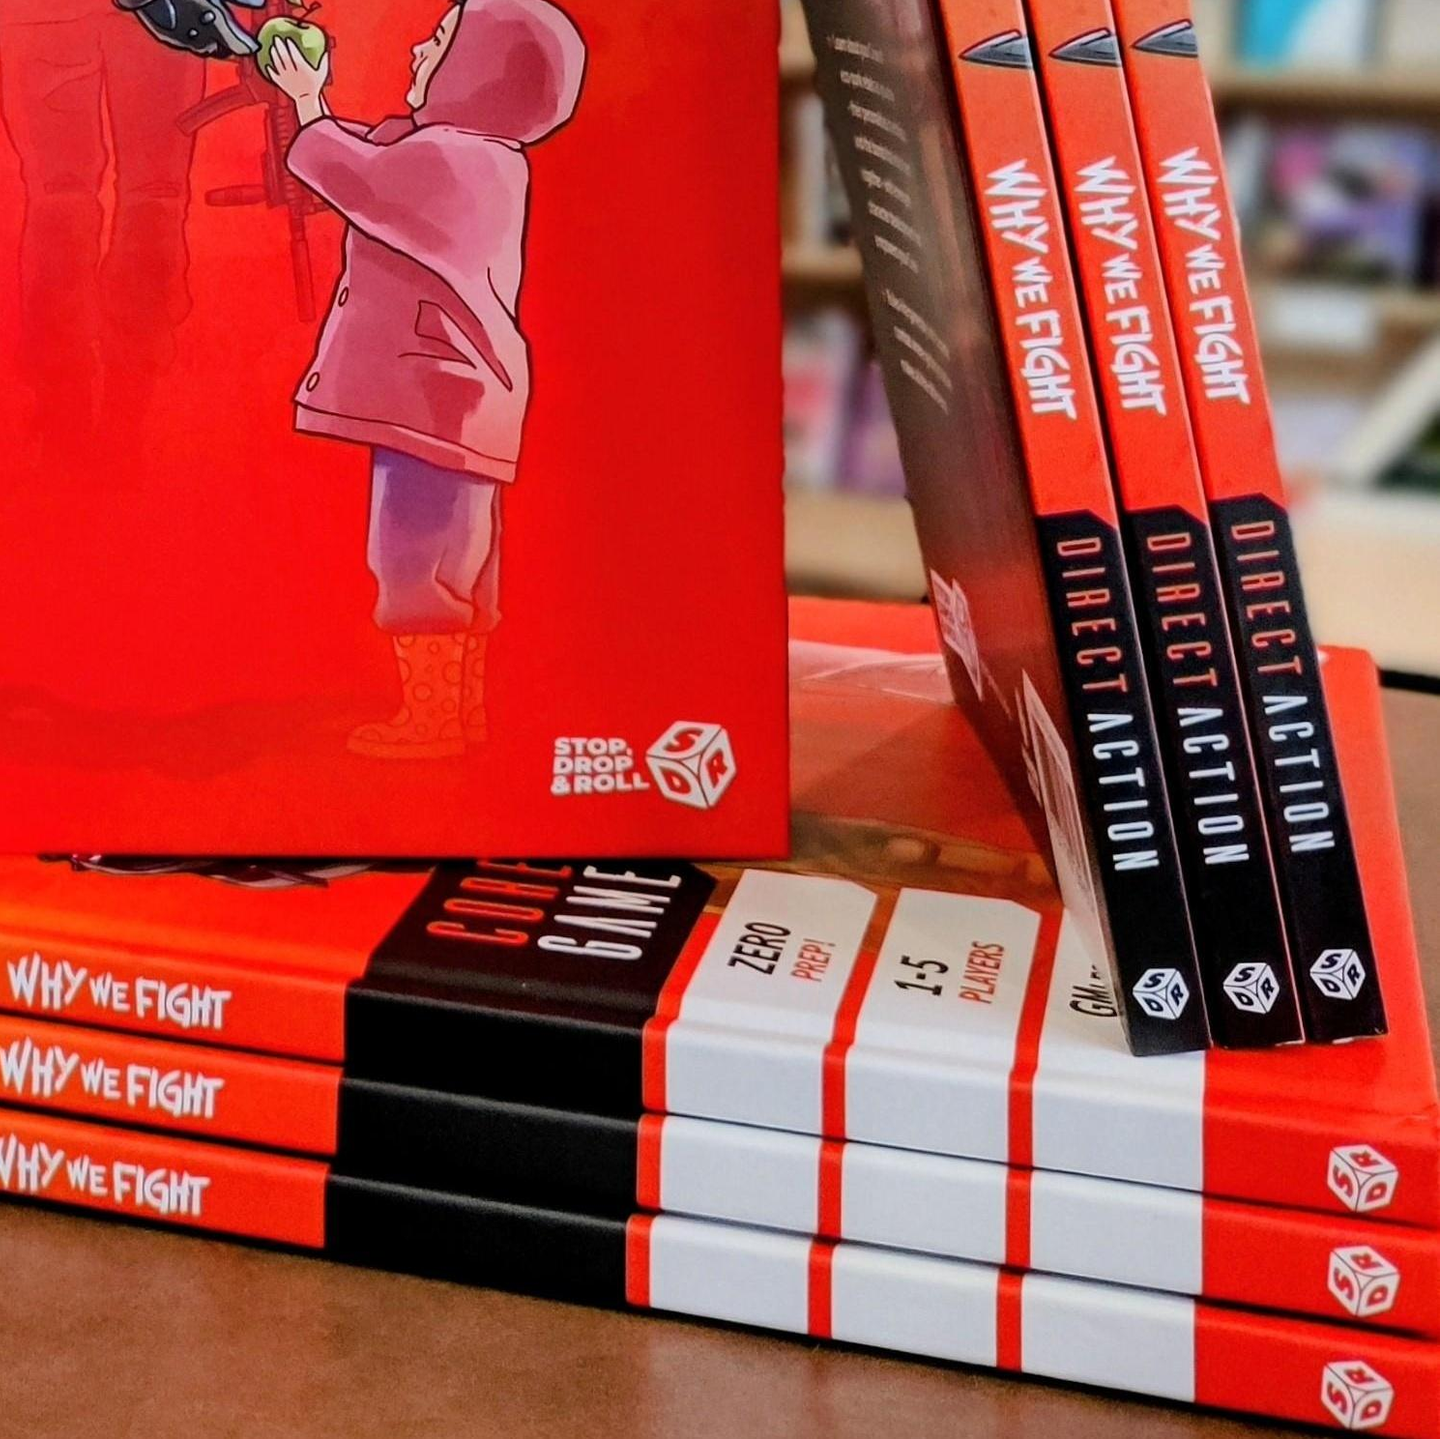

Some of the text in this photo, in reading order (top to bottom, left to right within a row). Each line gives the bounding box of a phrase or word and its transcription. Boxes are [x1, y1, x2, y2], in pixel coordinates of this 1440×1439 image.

[984, 158, 1077, 421] WHY WE FIGHT
[1074, 156, 1167, 416] WHY WE FIGHT
[1157, 147, 1250, 404] WHY WE FIGHT
[1056, 536, 1160, 871] DIRECT ACTION
[1147, 531, 1250, 865] DIRECT ACTION
[1231, 519, 1335, 853] DIRECT ACTION
[553, 755, 633, 775] DROP
[426, 860, 573, 947] CORE
[537, 864, 682, 961] GAME
[7, 951, 232, 1030] WHY WE FIGHT
[728, 922, 791, 976] ZERO
[791, 938, 836, 983] PREP!
[894, 954, 949, 997] 1-5
[958, 940, 1005, 1005] PLAYERS
[81, 1058, 121, 1100] WE
[127, 1063, 225, 1119] FIGHT
[67, 1155, 108, 1197] WE
[113, 1161, 210, 1217] FIGHT
